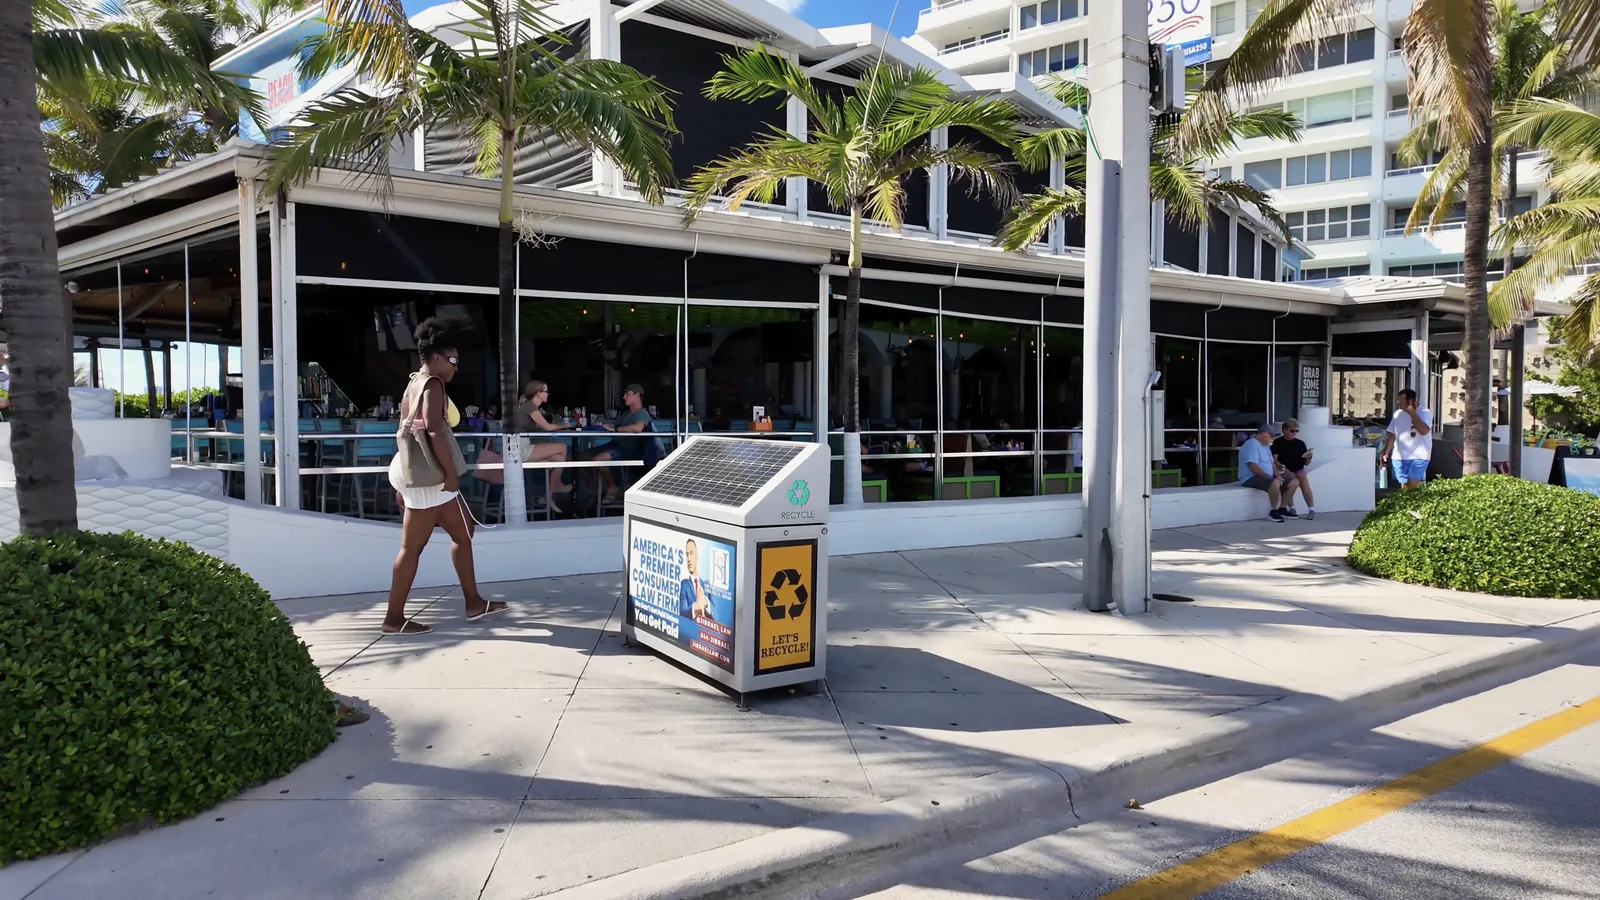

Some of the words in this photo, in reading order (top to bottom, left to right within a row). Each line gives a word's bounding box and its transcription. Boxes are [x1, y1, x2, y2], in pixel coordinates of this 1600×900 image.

[1303, 366, 1320, 379] GRAB
[1303, 379, 1320, 390] SOME
[781, 510, 815, 520] RECYCLE
[633, 536, 684, 565] AMERICA'S
[640, 553, 681, 582] PREMIER
[632, 568, 680, 599] CONSUMER
[636, 584, 655, 604] LAW
[657, 592, 680, 615] FIRM
[634, 608, 648, 625] You
[649, 614, 661, 631] Get
[662, 620, 679, 639] Paid
[761, 642, 809, 659] RECYCLE!
[772, 632, 799, 646] LET'S
